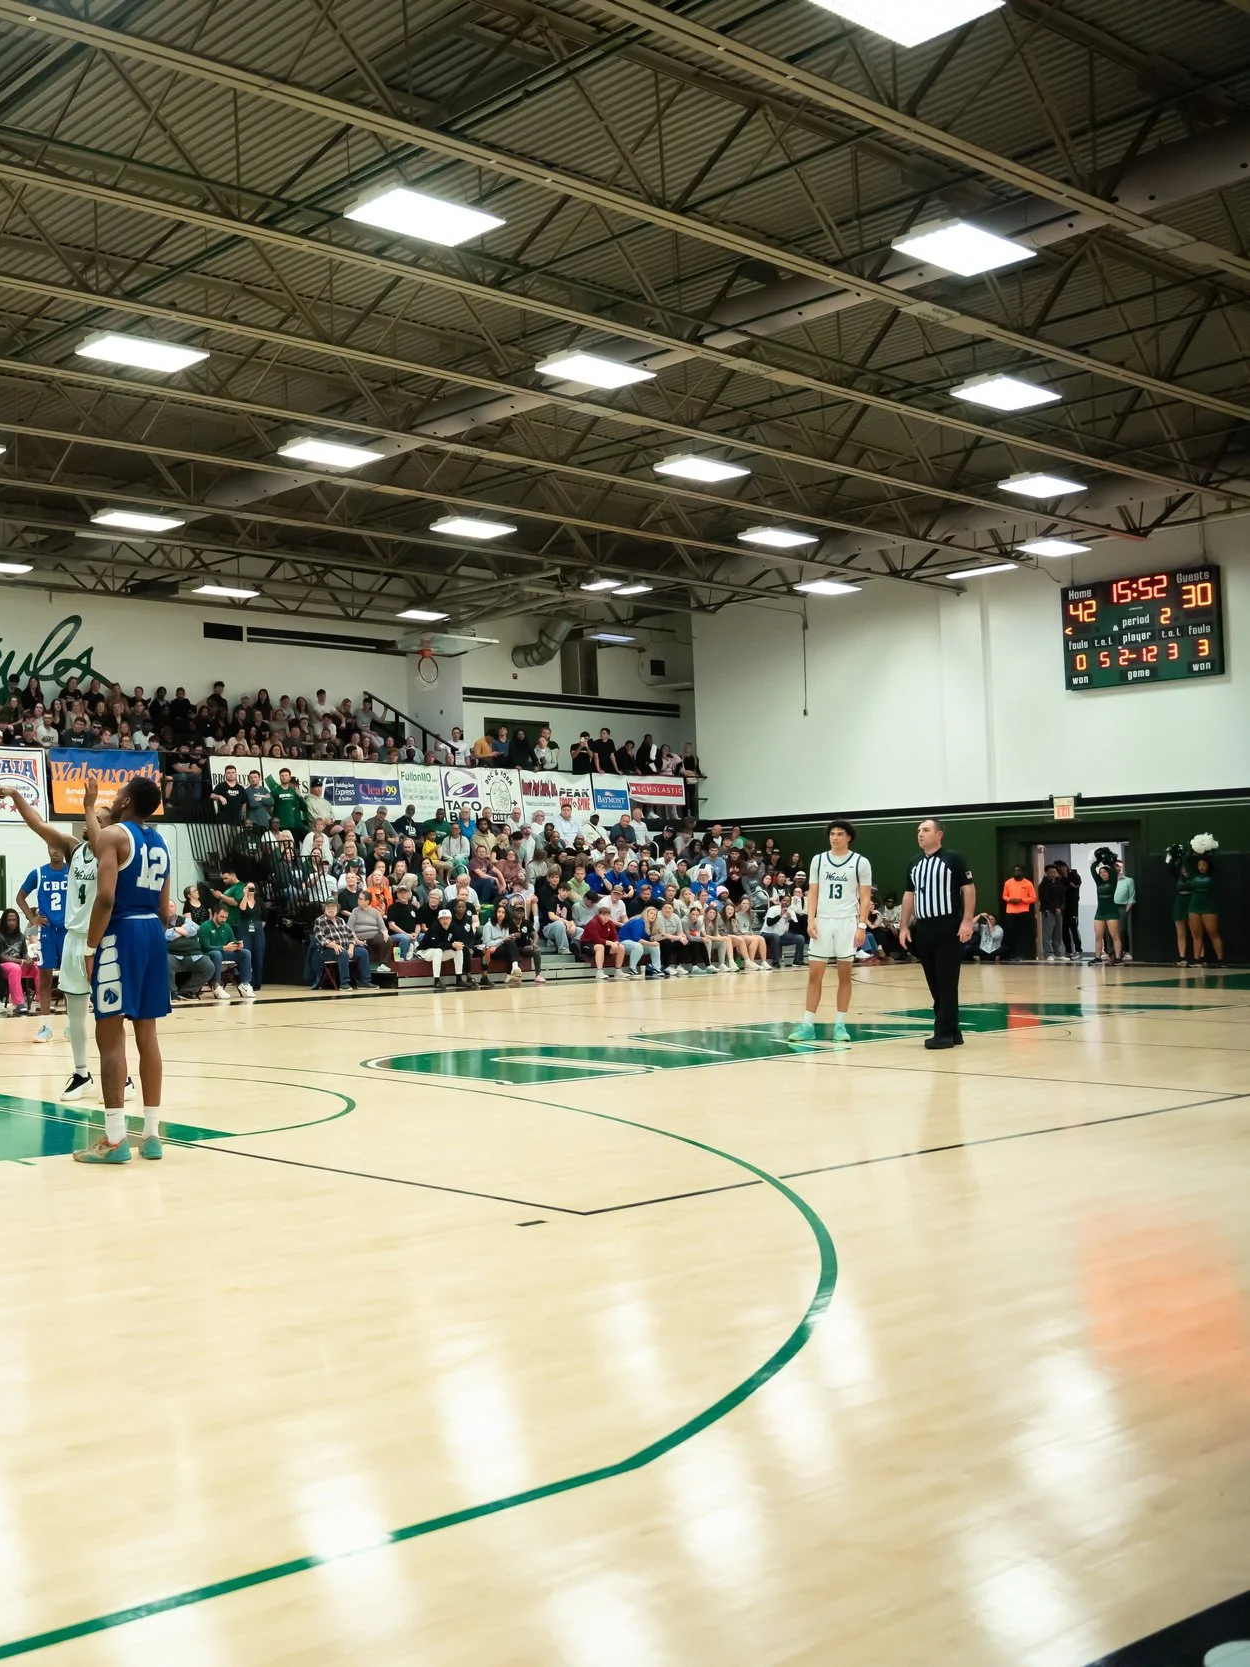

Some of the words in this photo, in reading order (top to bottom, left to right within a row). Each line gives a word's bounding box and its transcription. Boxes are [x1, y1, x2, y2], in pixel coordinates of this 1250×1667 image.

[1176, 571, 1210, 584] Guests
[1068, 589, 1092, 600] Home
[1112, 575, 1168, 603] 15:52
[1181, 582, 1212, 609] 30
[1069, 600, 1097, 622] 42
[1122, 614, 1150, 628] period
[1160, 607, 1172, 625] 2
[1188, 624, 1211, 636] fouls
[1068, 639, 1089, 651] fouls
[1122, 631, 1151, 645] player
[1167, 642, 1179, 660] 3
[1198, 639, 1210, 657] 3
[1076, 654, 1087, 671] 0
[1100, 651, 1111, 668] 5
[1192, 662, 1211, 672] won
[1072, 675, 1089, 685] won
[1127, 668, 1150, 681] game
[50, 760, 162, 784] Walsworth
[359, 784, 385, 796] Clear
[385, 785, 397, 796] 99
[559, 788, 589, 797] PEAK
[637, 786, 682, 794] SCHOLASTIC
[1057, 806, 1070, 817] EXIT
[136, 843, 168, 892] 12
[43, 881, 67, 891] CBC
[829, 884, 842, 899] 13
[78, 884, 86, 904] 4
[50, 892, 61, 911] 2
